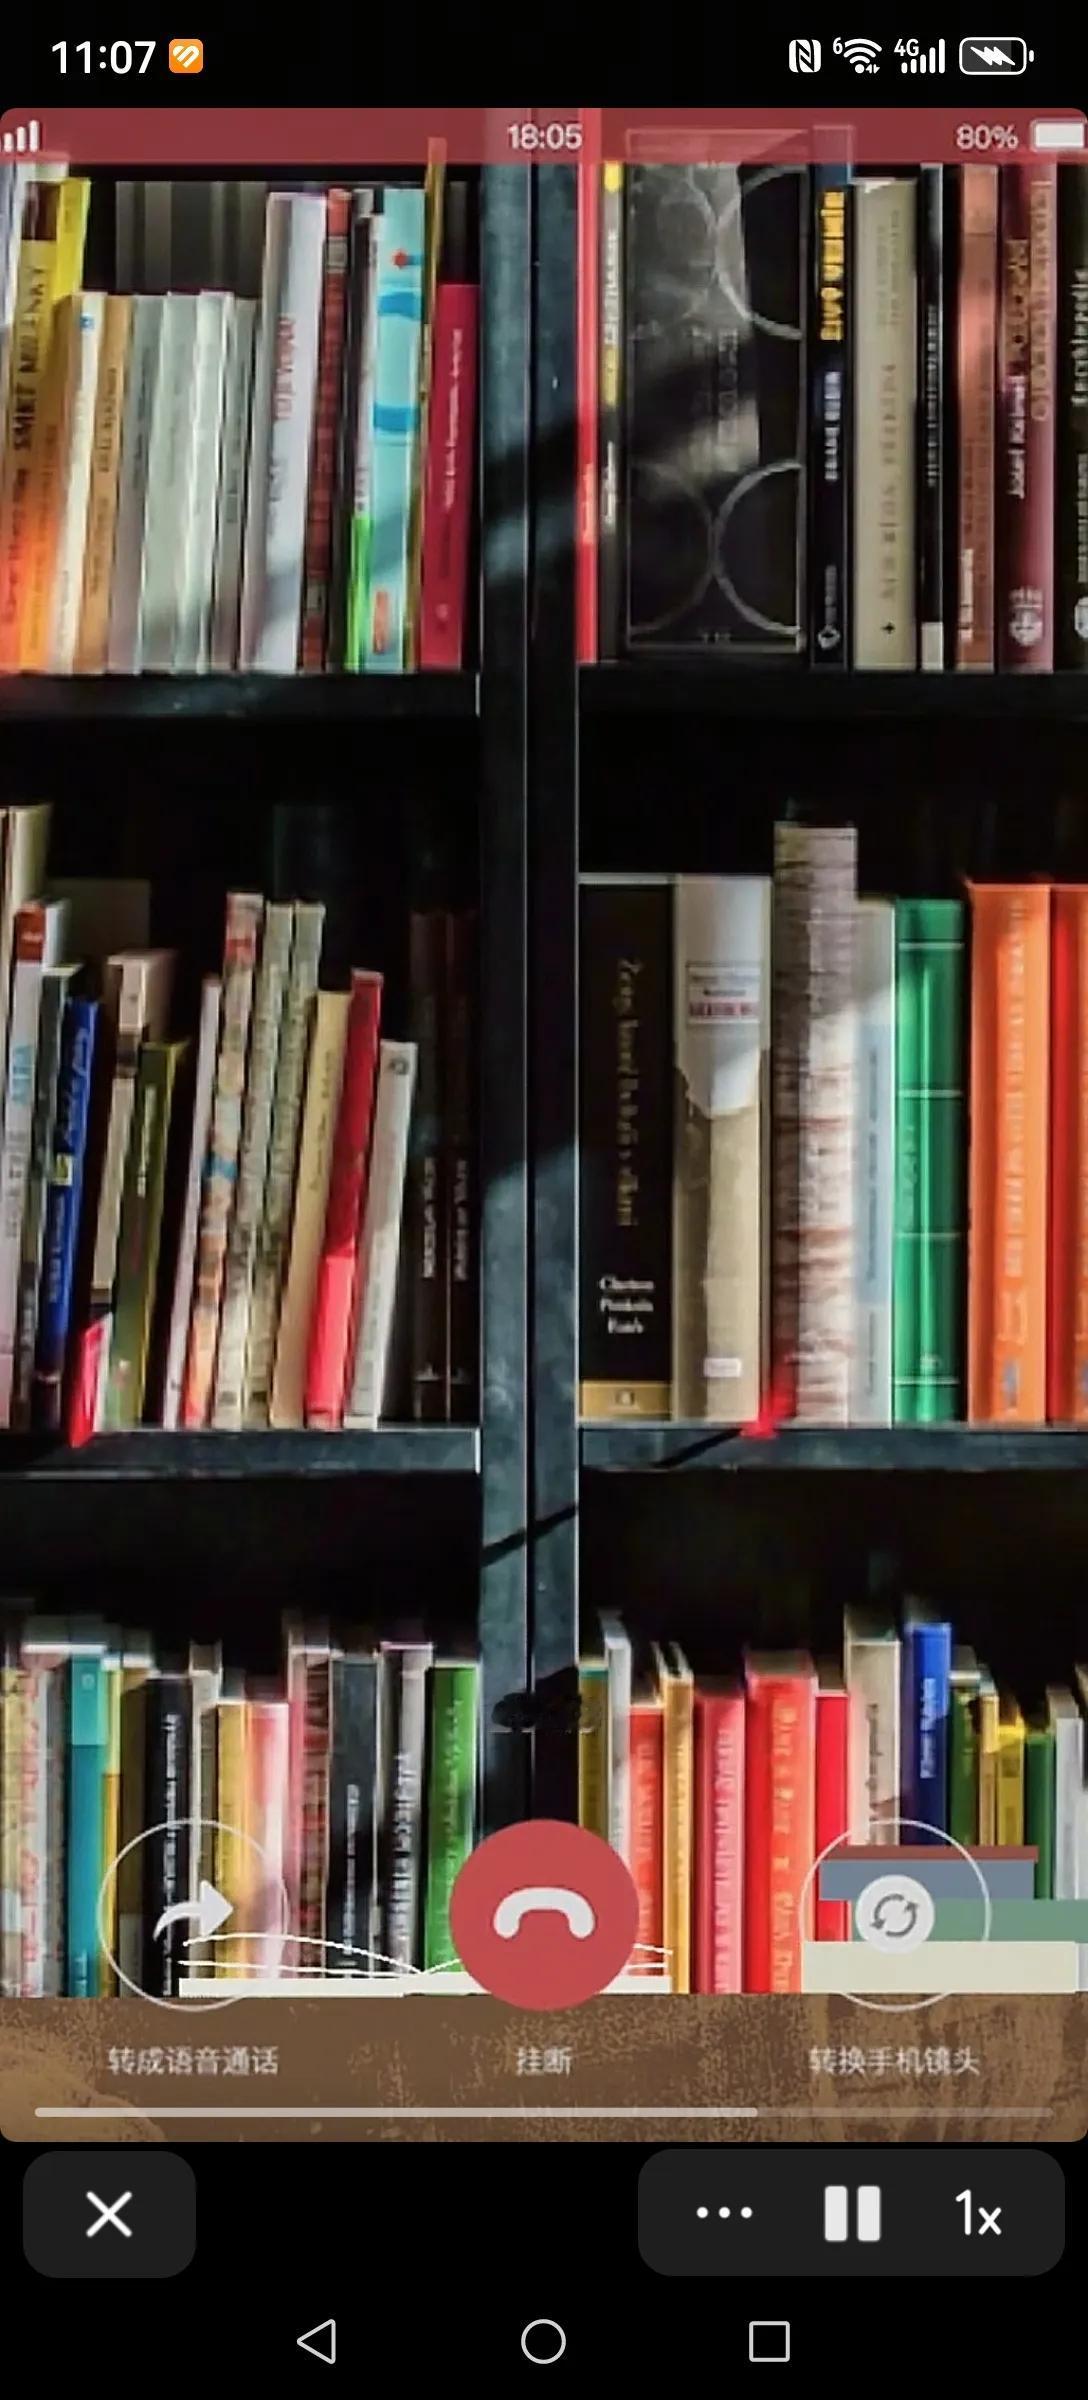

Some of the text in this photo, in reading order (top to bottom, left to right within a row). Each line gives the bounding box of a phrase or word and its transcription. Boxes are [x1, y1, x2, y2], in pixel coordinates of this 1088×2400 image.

[51, 41, 157, 75] 11:07
[894, 38, 920, 57] 4G
[507, 123, 583, 150] 18:05
[956, 124, 1019, 150] 80%
[108, 2045, 280, 2076] 转成语音通话
[516, 2045, 573, 2077] 挂断
[808, 2044, 982, 2078] 转换手机镜头
[955, 2188, 1002, 2236] 1x
